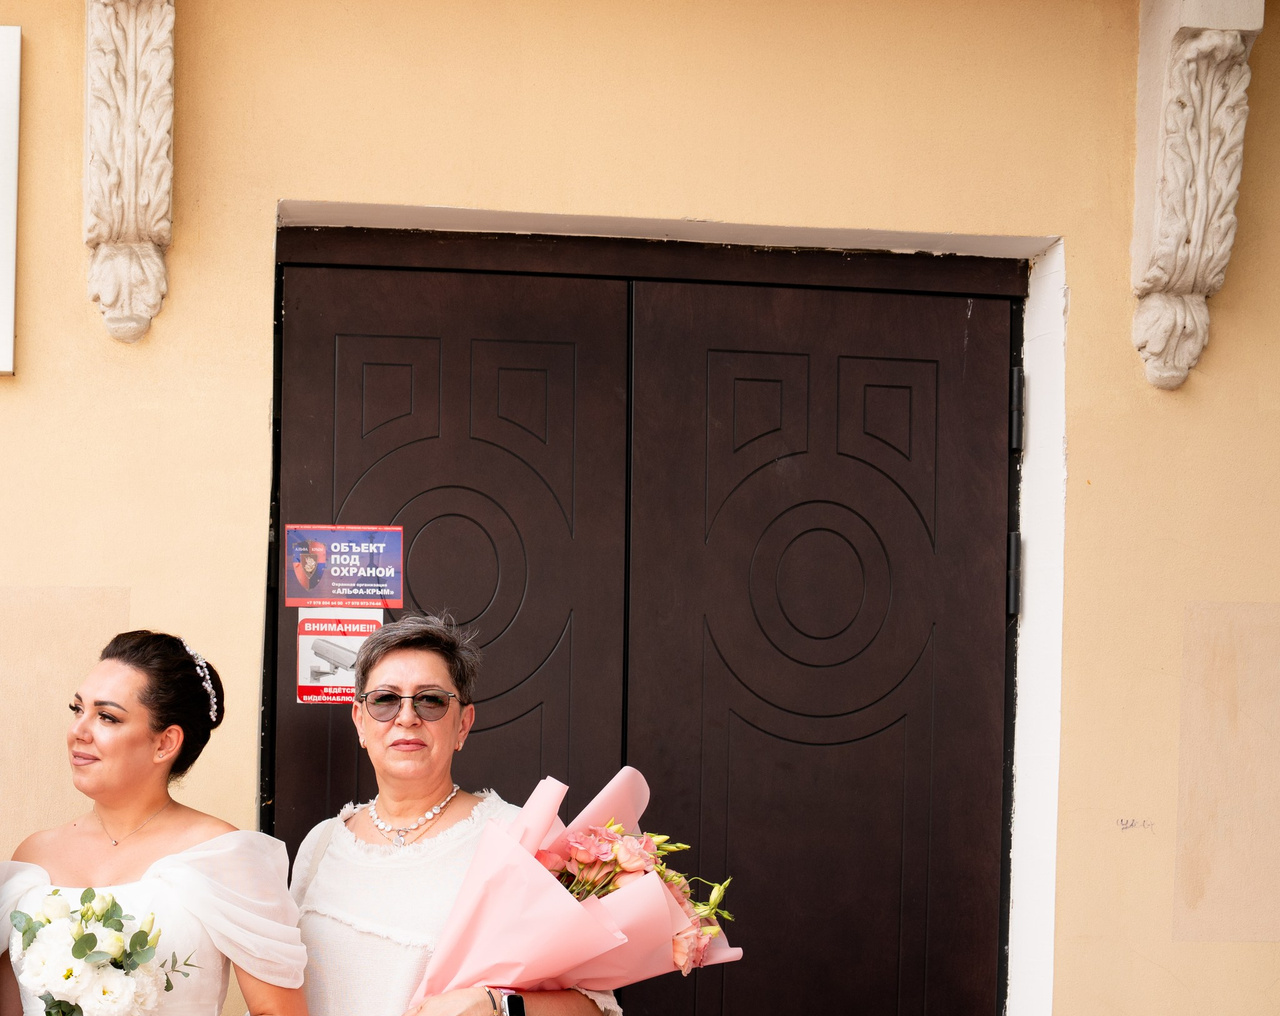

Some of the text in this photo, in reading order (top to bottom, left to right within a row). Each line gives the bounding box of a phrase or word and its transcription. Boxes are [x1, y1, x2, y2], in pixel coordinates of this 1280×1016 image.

[330, 542, 387, 553] ОБЪЕКТ
[330, 554, 360, 566] ПОД
[330, 565, 395, 577] ОХРАНОЙ
[304, 622, 377, 633] ВНИМАНИЕ!!!
